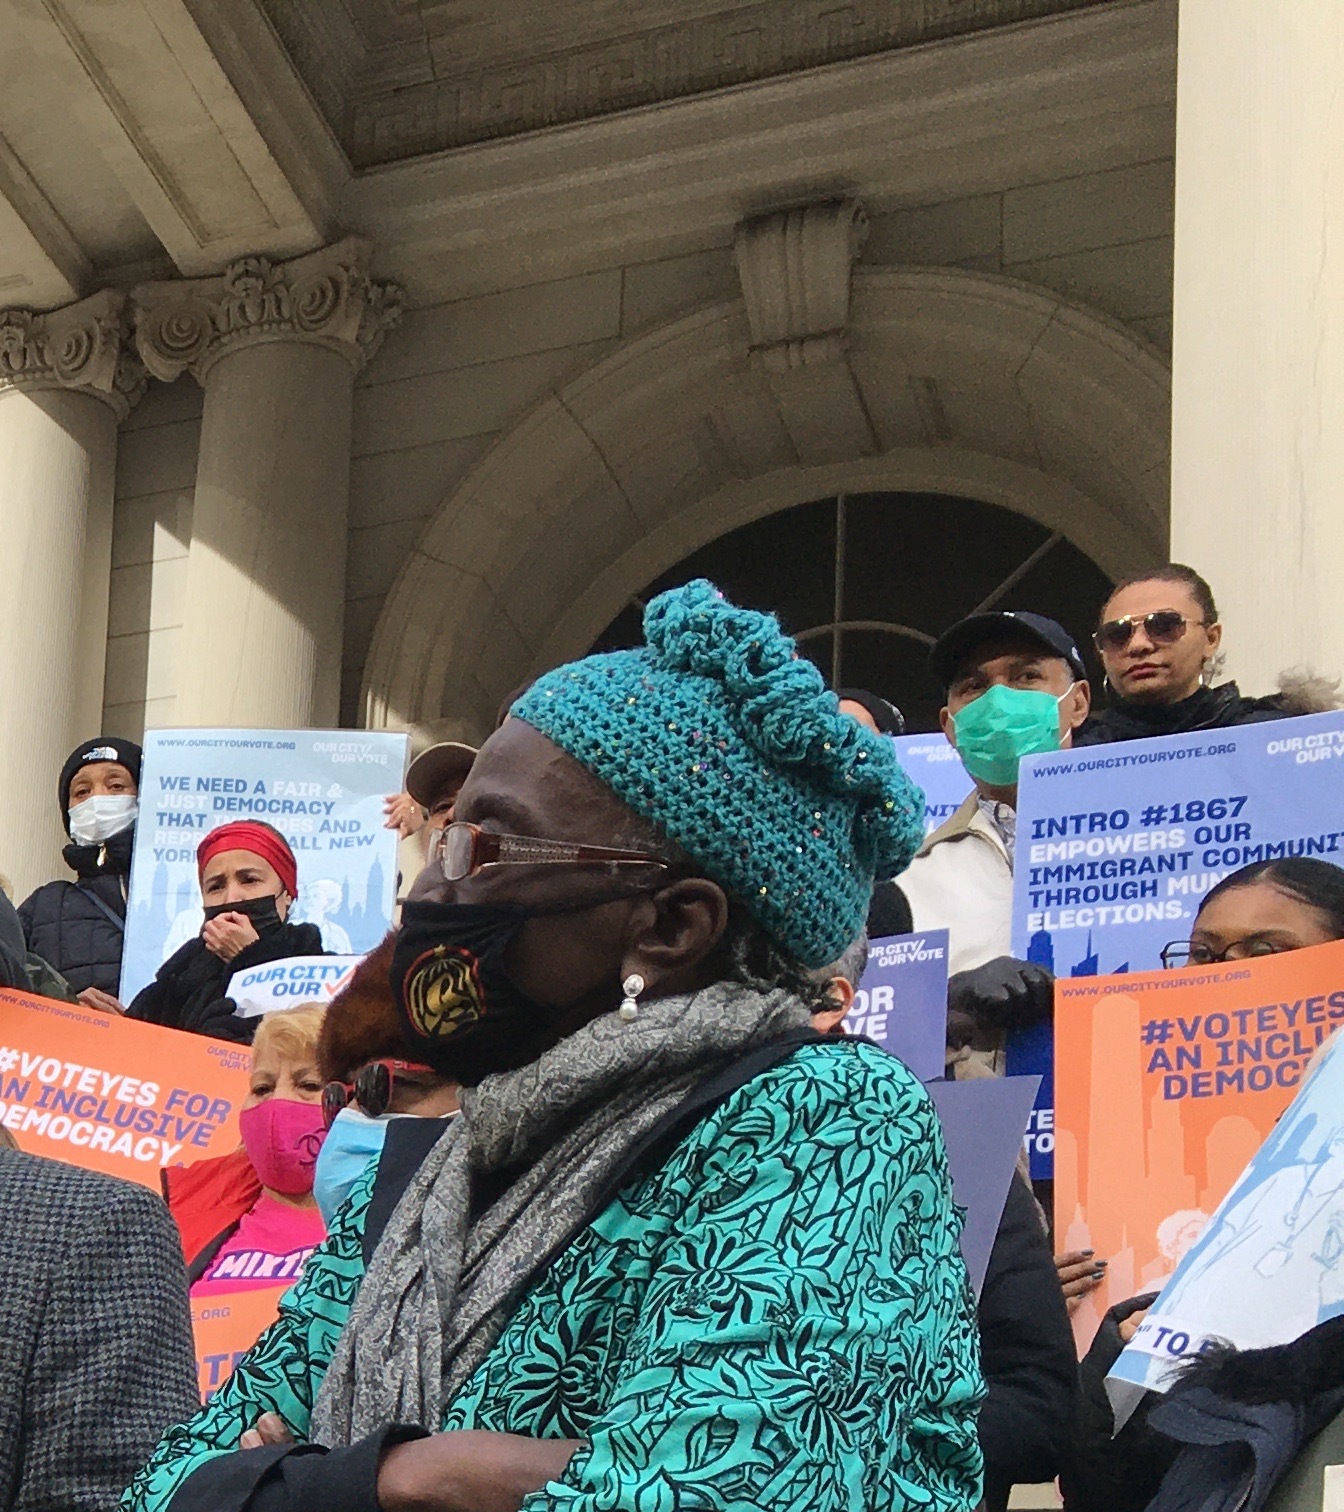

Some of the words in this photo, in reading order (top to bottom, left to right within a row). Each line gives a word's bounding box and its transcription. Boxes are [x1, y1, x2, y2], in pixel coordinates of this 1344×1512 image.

[157, 739, 296, 750] WWW.OURCITYOURVOTE.ORG
[313, 741, 339, 753] OUR
[1267, 738, 1303, 755] OUR
[331, 752, 355, 763] OUR
[1032, 743, 1237, 778] WWW.OURCITYOURVOTE.ORG
[1295, 748, 1331, 764] OUR
[159, 776, 191, 792] WE
[196, 777, 248, 793] NEED
[253, 779, 267, 794] A
[272, 781, 323, 797] FAIR
[325, 783, 343, 798] &
[156, 794, 207, 811] JUST
[213, 797, 336, 816] DEMOCRACY
[156, 812, 208, 828] THAT
[318, 819, 361, 833] AND
[1031, 808, 1130, 840] INTRO
[1140, 796, 1249, 828] #1867
[289, 836, 322, 850] ALL
[328, 833, 377, 849] NEW
[1030, 827, 1187, 864] EMPOWERS
[1193, 823, 1252, 846] OUR
[1029, 850, 1194, 888] IMMIGRANT
[1029, 878, 1159, 908] THROUGH
[1167, 871, 1229, 896] MUN
[1027, 900, 1192, 932] ELECTIONS.
[878, 953, 911, 967] OUR
[909, 947, 944, 962] VOTE
[888, 941, 921, 955] CITY
[240, 968, 287, 988] OUR
[289, 965, 350, 982] CITY
[1062, 970, 1251, 998] WWW.OURCITYOURVOTE.ORG
[272, 981, 321, 997] OUR
[850, 985, 894, 1016] OR
[206, 1045, 230, 1059] OUR
[1147, 1042, 1202, 1075] AN
[219, 1058, 242, 1070] OUR
[1163, 1059, 1307, 1101] DEMOC
[34, 1085, 217, 1148] INCLUSIVE
[164, 1088, 232, 1124] FOR
[1152, 1326, 1190, 1356] TO
